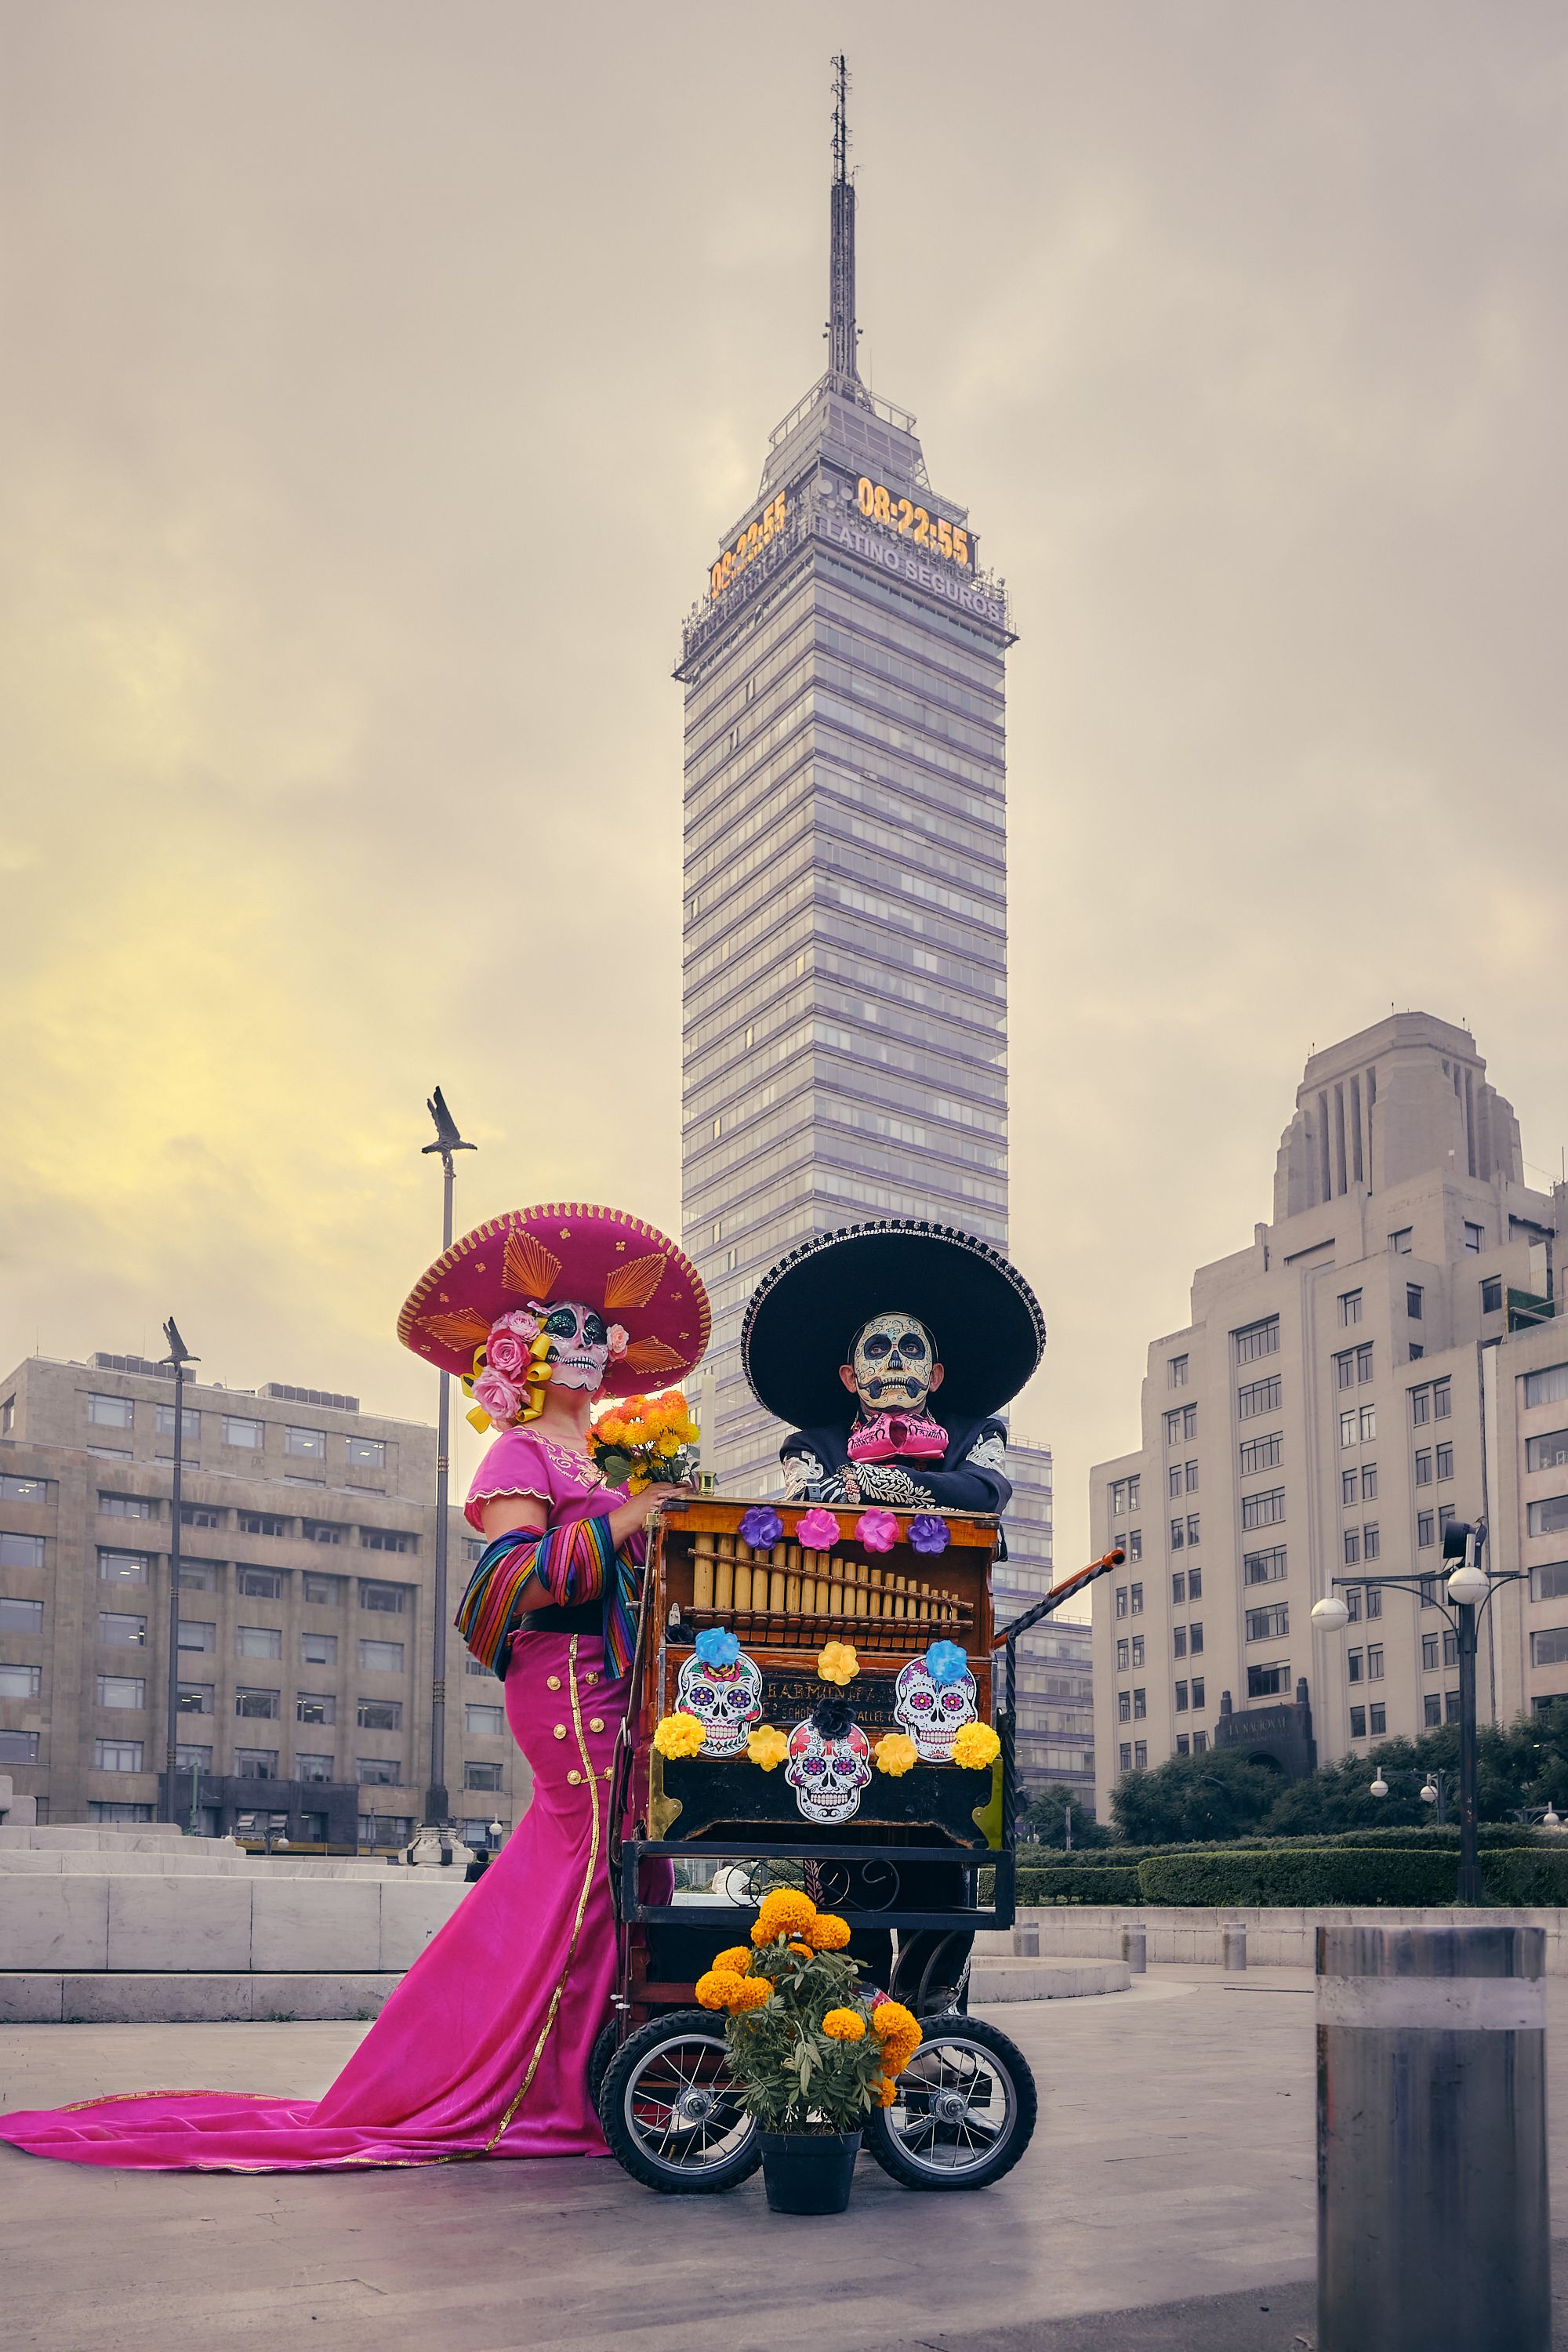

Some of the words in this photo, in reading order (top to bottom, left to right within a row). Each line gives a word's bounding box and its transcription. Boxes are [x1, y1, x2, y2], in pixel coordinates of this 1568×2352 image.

[858, 477, 968, 565] 08:22:55
[826, 517, 899, 569] LATINO
[906, 559, 1000, 621] SEGUROS
[1229, 1724, 1239, 1735] LA
[1243, 1716, 1286, 1733] NACIONAL
